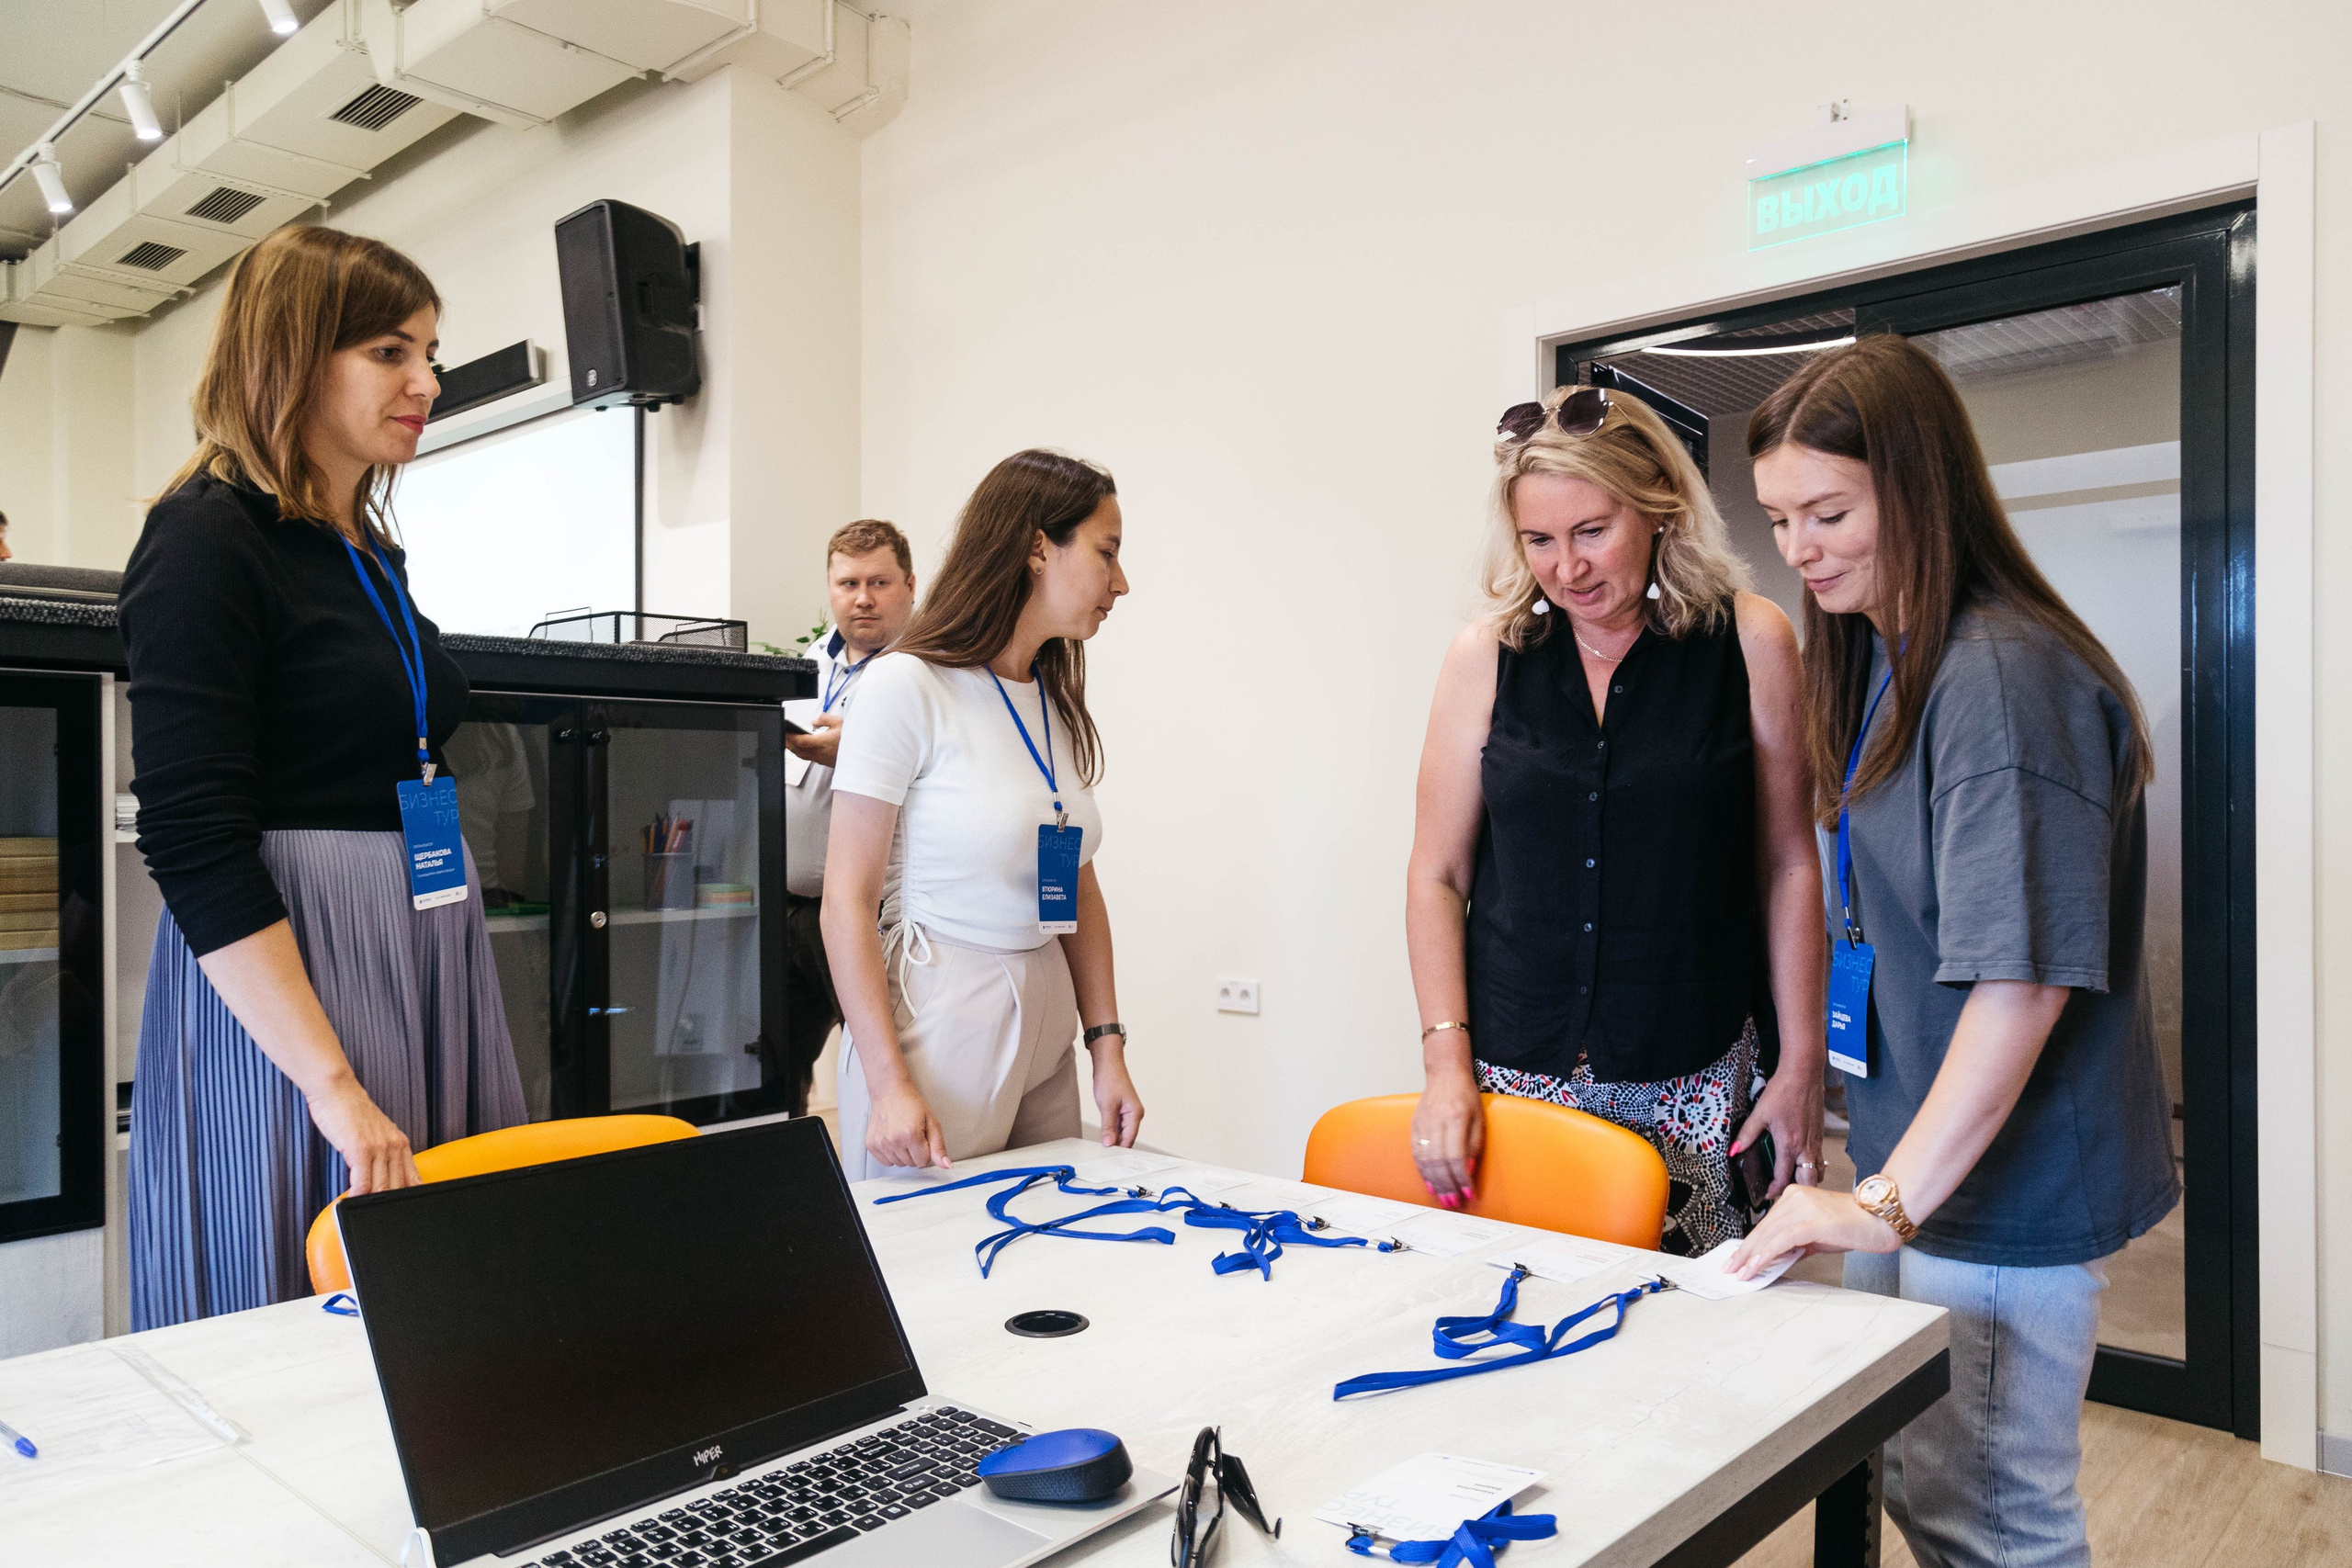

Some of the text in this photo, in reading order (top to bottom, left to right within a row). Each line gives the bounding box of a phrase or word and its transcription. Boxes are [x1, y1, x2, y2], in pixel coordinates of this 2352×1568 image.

[1757, 163, 1899, 235] ВЫХОД
[399, 789, 458, 810] БИЗНЕС
[434, 808, 459, 826] ТУР
[1038, 834, 1081, 851] БИЗНЕС
[413, 848, 452, 862] ЩЕРБАКОВА
[415, 858, 444, 870] НАТАЛЬЯ
[1833, 951, 1873, 974] БИЗНЕС
[1851, 976, 1870, 994] ТУР
[1832, 1010, 1851, 1023] ЗАЙЦЕВА
[1831, 1021, 1846, 1031] ДАРЬЯ
[693, 1445, 723, 1467] HIPER
[1342, 1490, 1401, 1510] ТУР
[1320, 1500, 1454, 1540] БИЗНЕС
